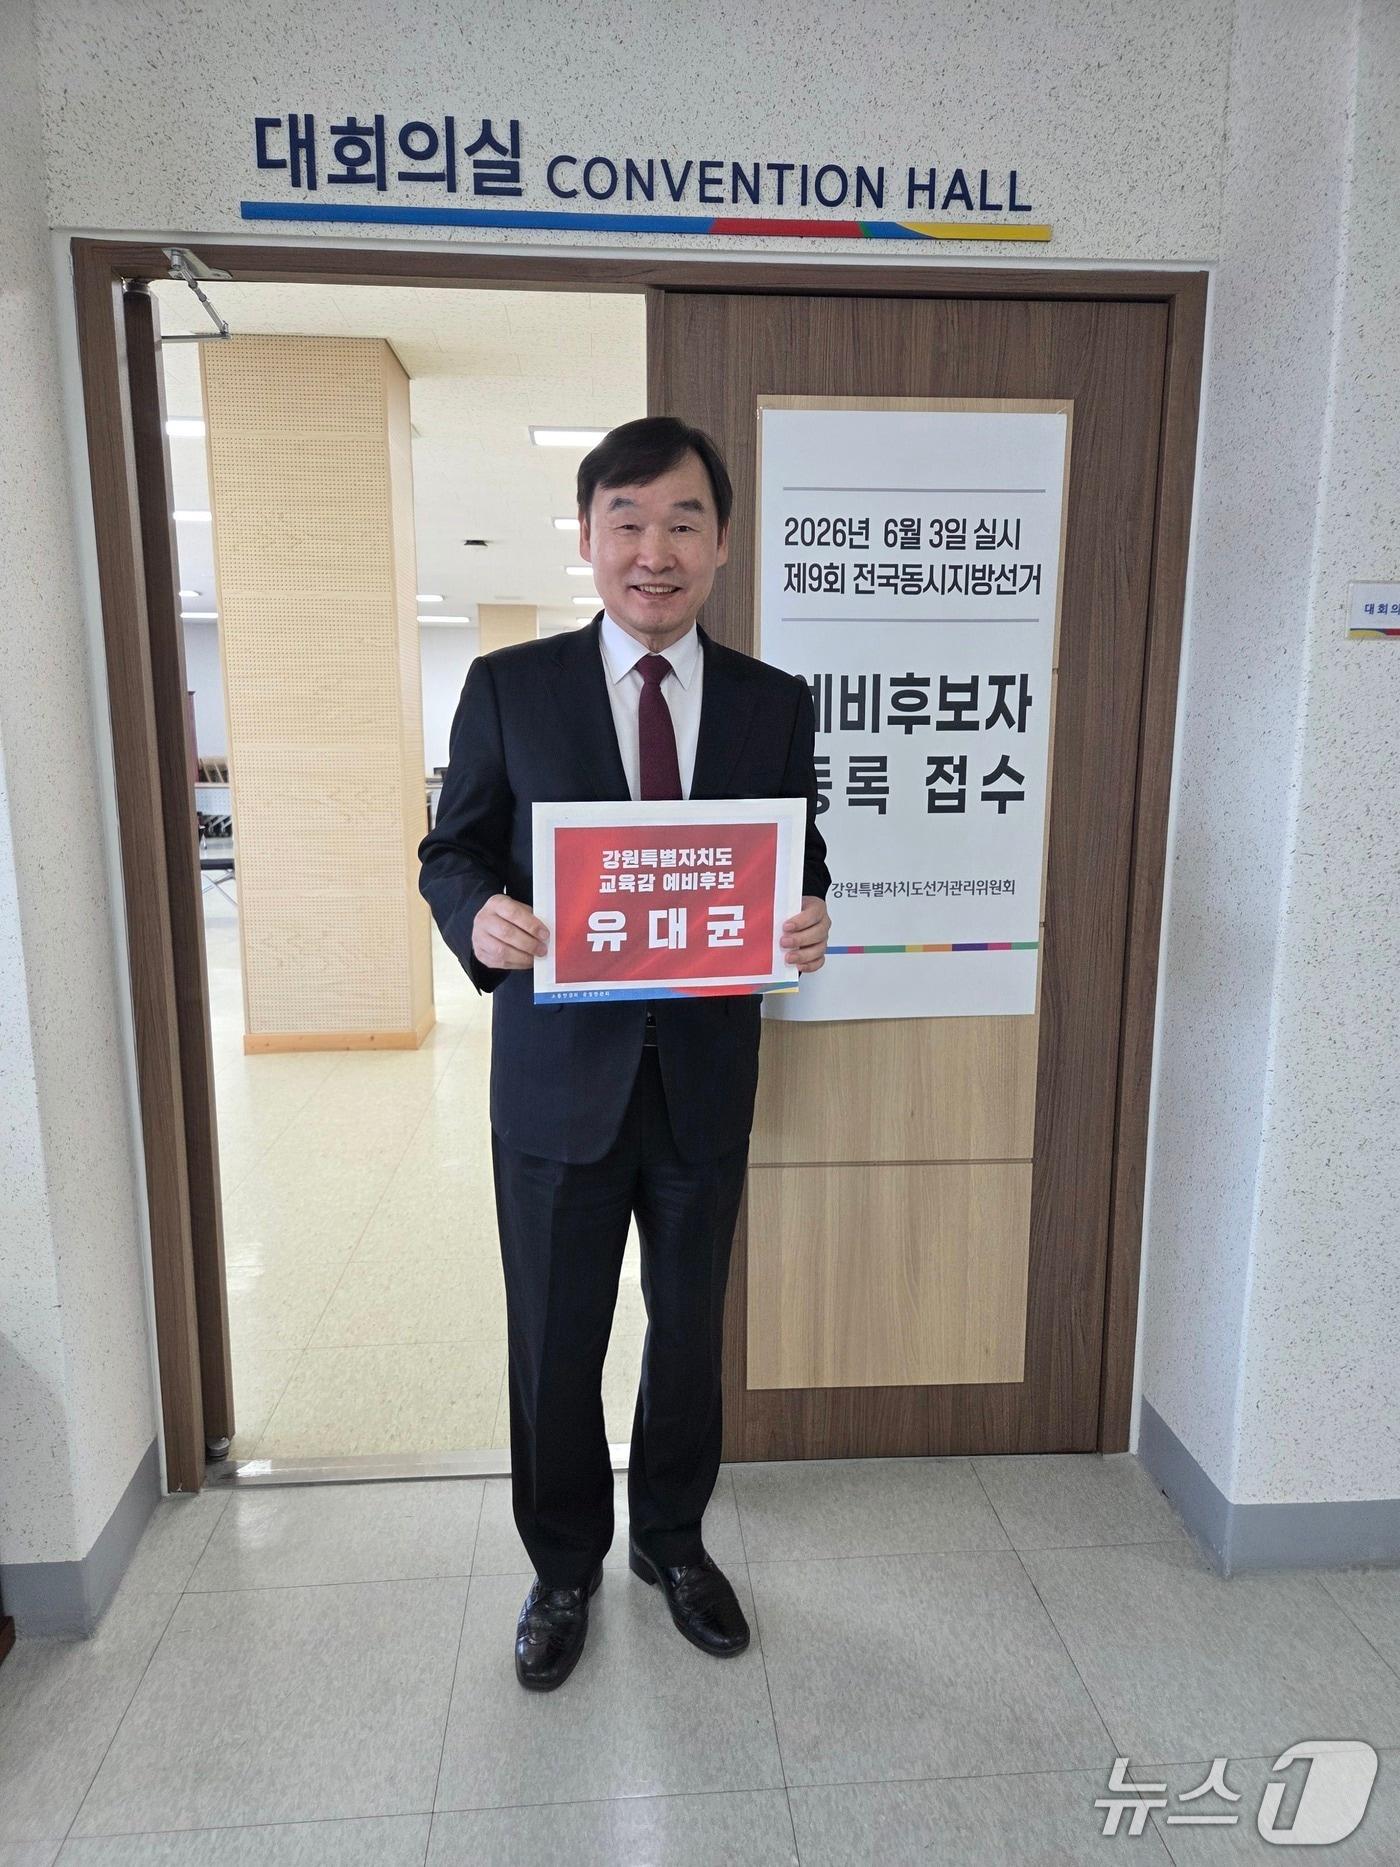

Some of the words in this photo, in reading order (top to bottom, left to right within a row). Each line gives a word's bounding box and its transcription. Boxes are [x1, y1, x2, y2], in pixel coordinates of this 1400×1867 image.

[254, 113, 525, 196] 대회의실
[546, 154, 885, 208] CONVENTION
[907, 167, 1033, 212] HALL
[784, 517, 870, 550] 2026년
[883, 517, 922, 550] 6월
[928, 518, 967, 550] 3일
[973, 518, 1021, 551] 실시
[783, 562, 846, 595] 제9회
[853, 563, 1042, 596] 전국동시지방선거
[925, 754, 1026, 815] 접수
[602, 847, 733, 870] 강원특별자치도
[599, 873, 656, 894] 교육감
[662, 871, 735, 891] 예비후보
[831, 879, 1016, 899] 강원특별자치도선거관리위원회
